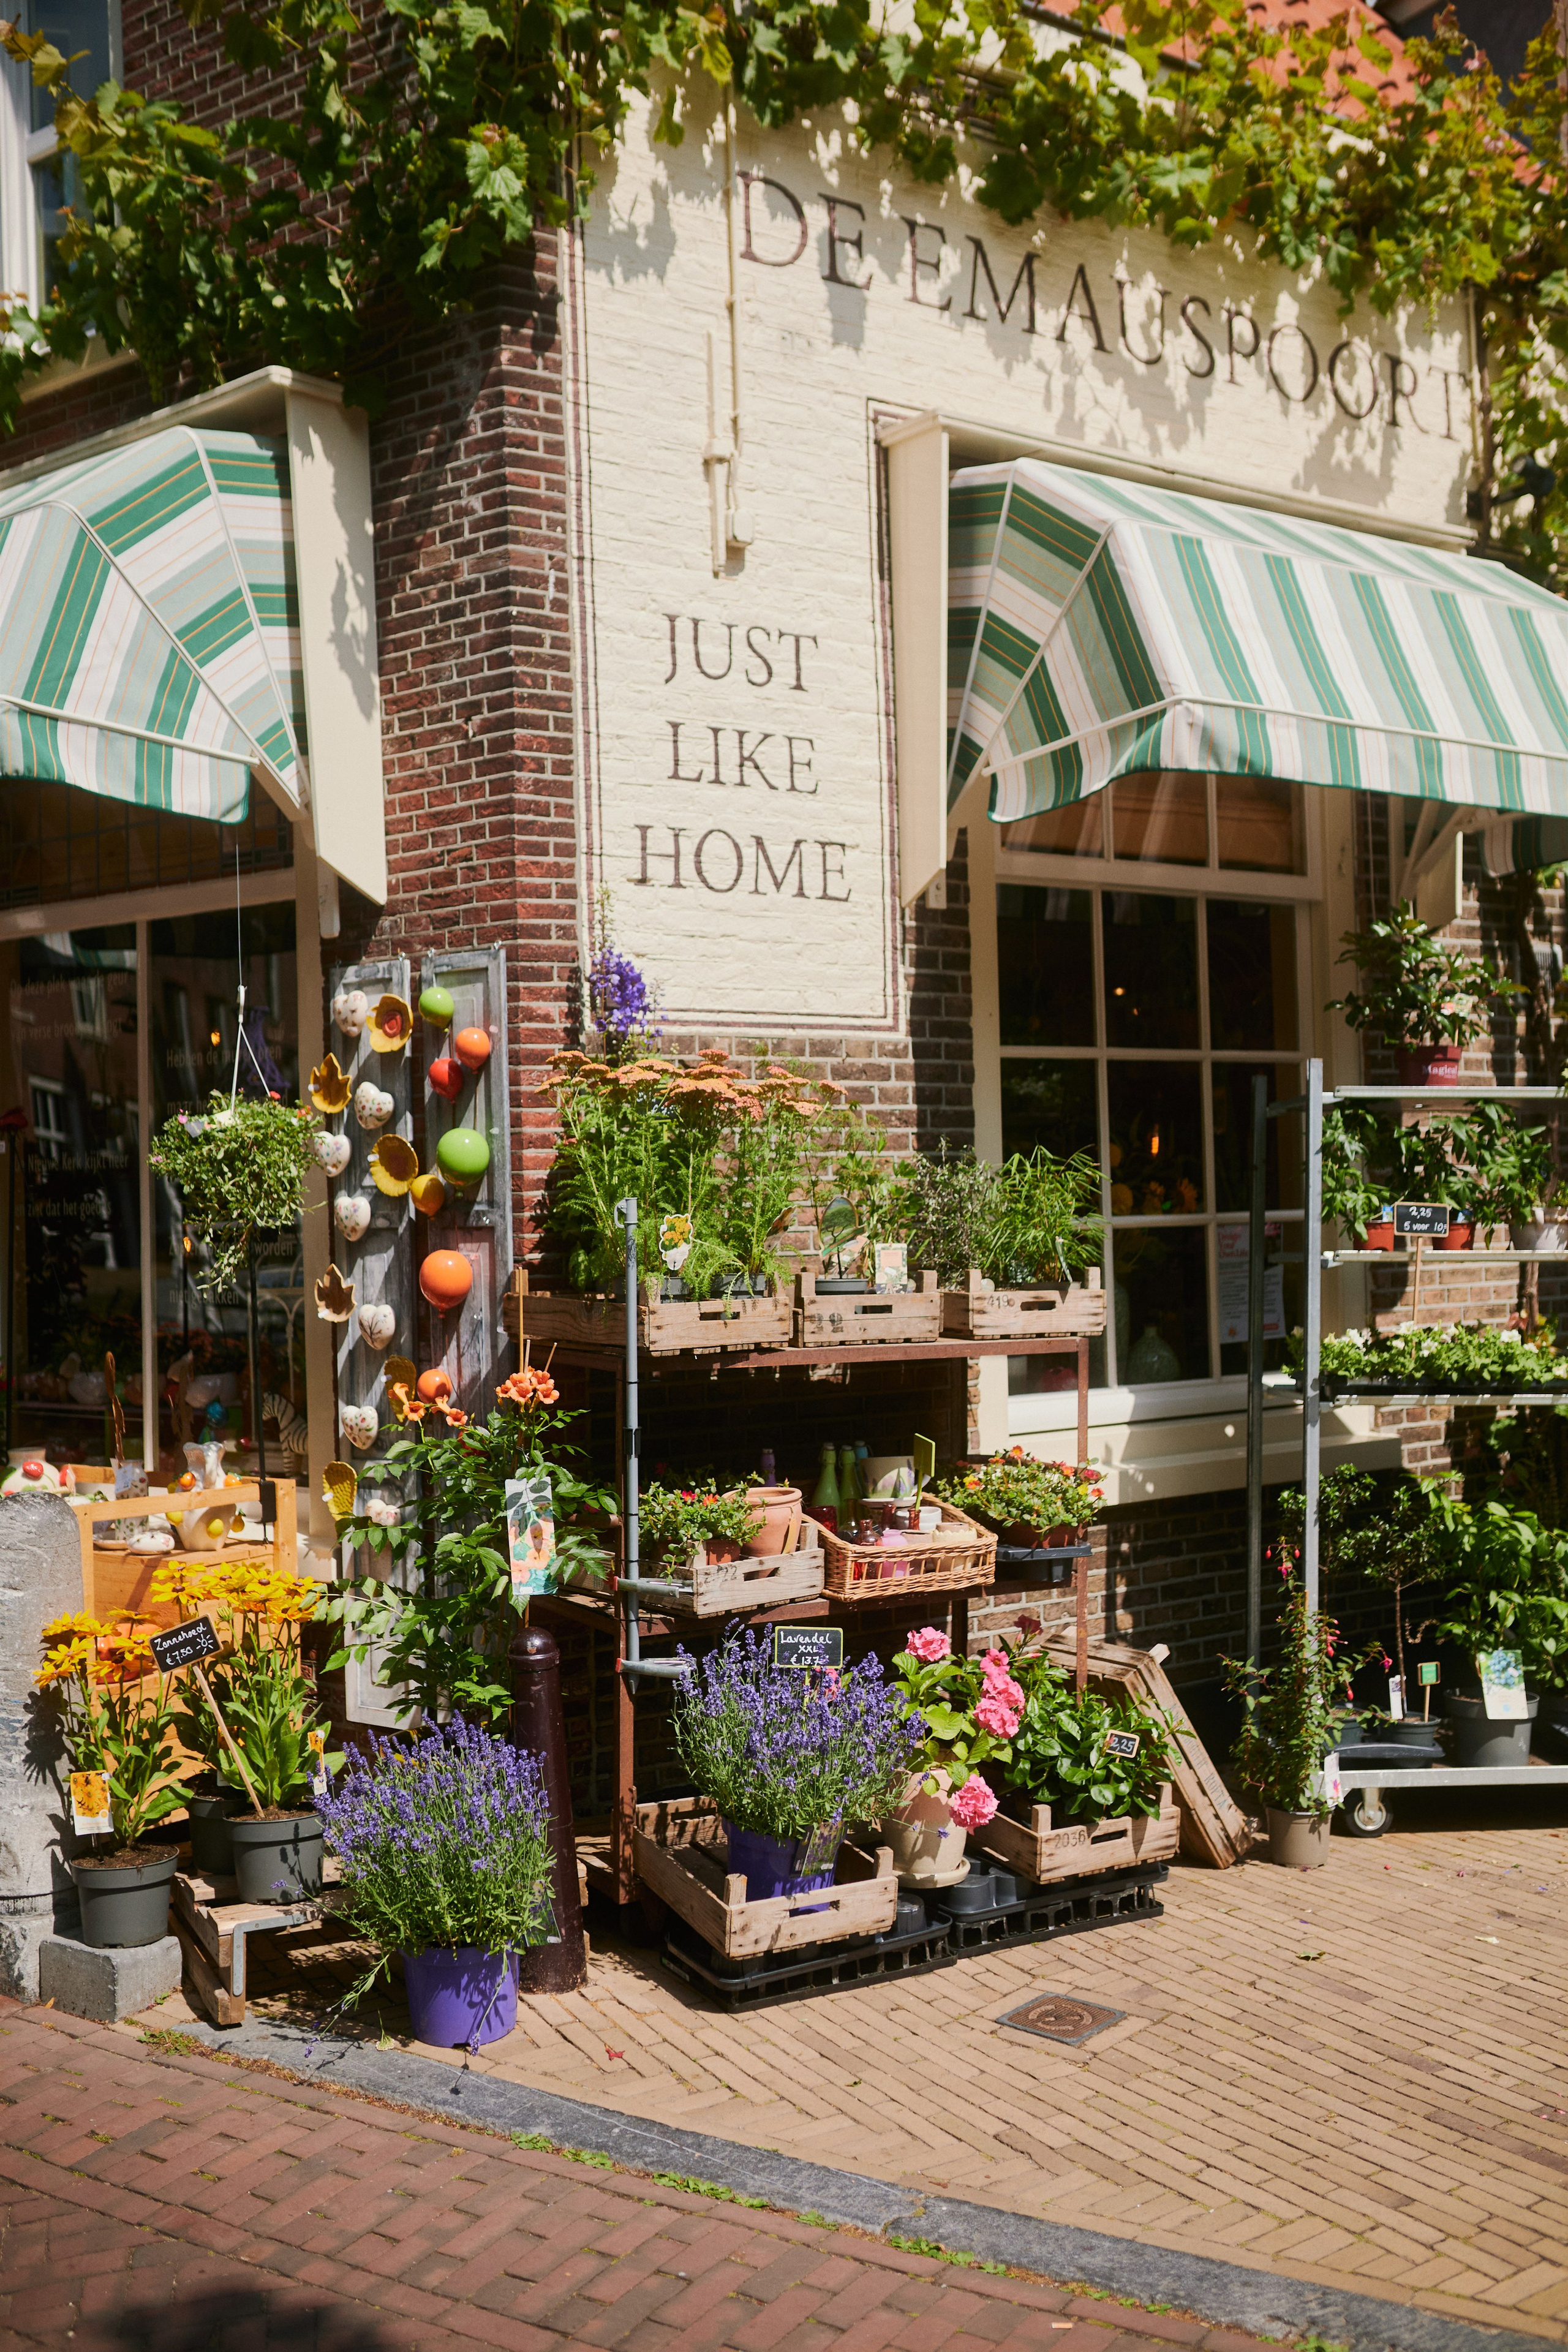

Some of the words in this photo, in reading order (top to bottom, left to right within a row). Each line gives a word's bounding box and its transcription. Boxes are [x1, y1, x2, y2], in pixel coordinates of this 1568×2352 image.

[736, 168, 872, 292] DE
[900, 212, 1471, 442] EMAUSPOORT
[662, 613, 818, 692] JUST
[666, 720, 819, 794] LIKE
[633, 823, 852, 903] HOME
[62, 1151, 82, 1172] Kerk
[45, 1197, 61, 1217] dat
[63, 1197, 77, 1216] het
[1409, 1205, 1433, 1219] 2,25
[1412, 1223, 1430, 1232] voor
[780, 1630, 832, 1644] Lavendel
[797, 1645, 820, 1654] XXL
[1109, 1736, 1136, 1753] 2,25
